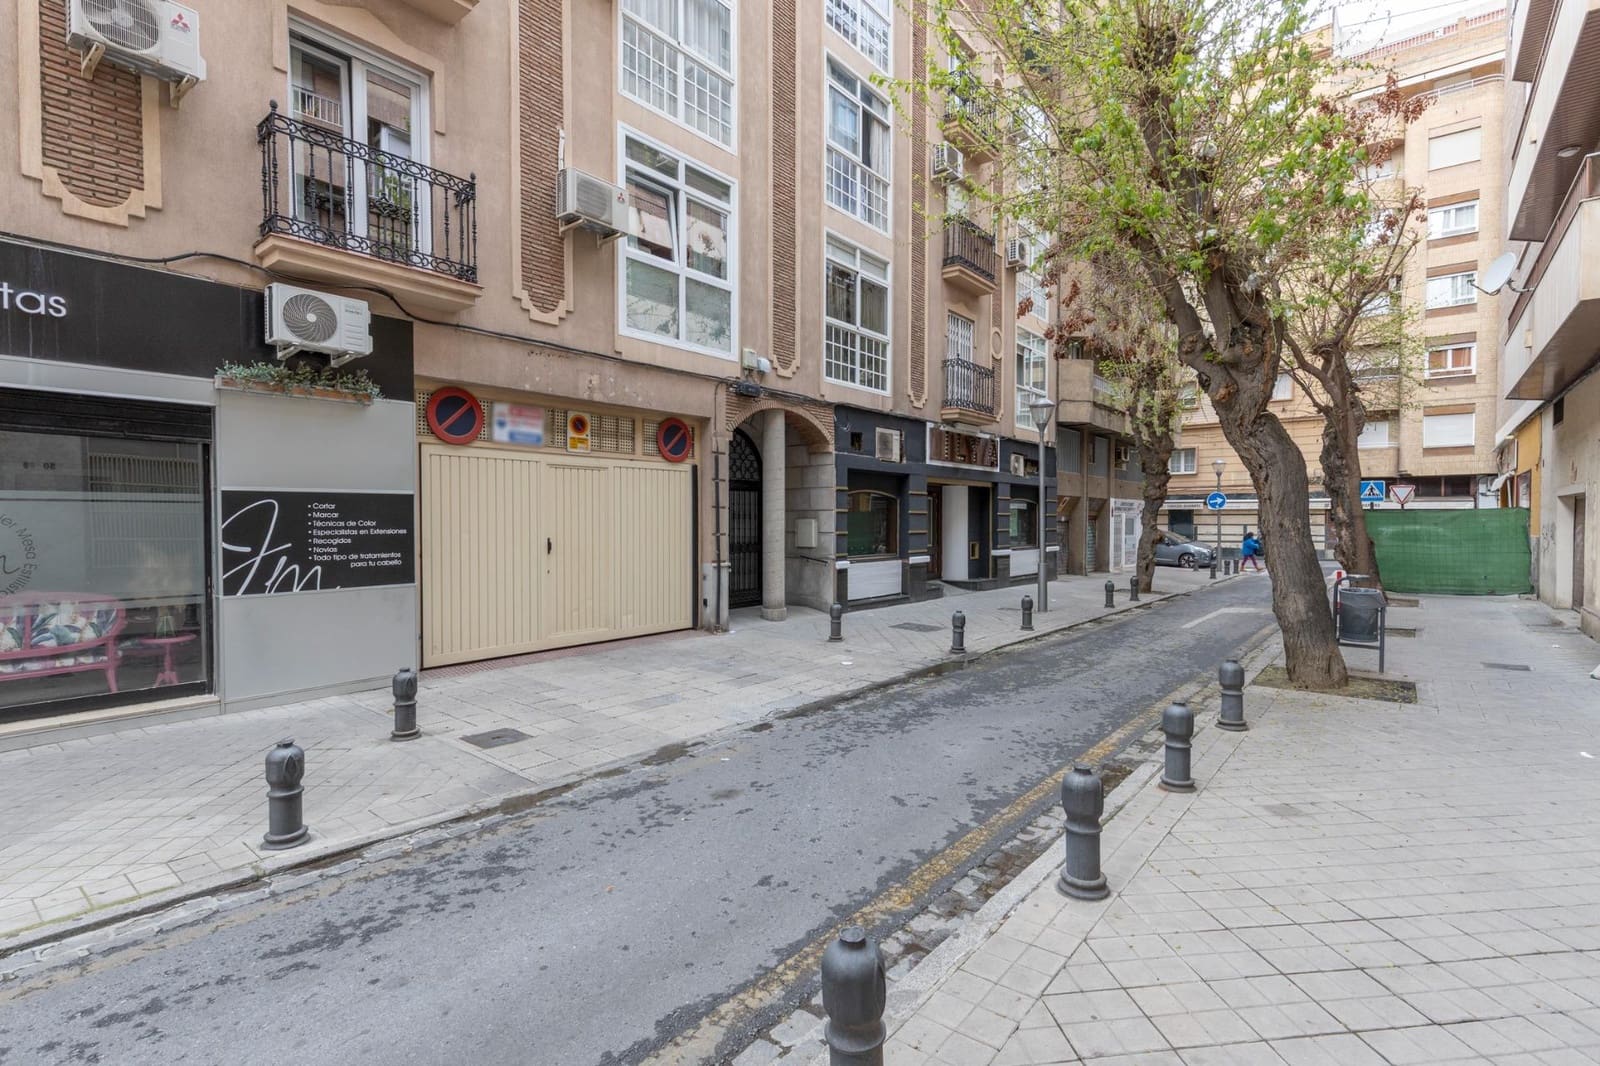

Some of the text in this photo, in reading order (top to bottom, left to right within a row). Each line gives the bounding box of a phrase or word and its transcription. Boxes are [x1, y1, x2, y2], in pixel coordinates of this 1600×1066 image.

[312, 502, 336, 510] Cortar
[313, 528, 358, 536] Especialistas
[16, 527, 37, 560] Mesa
[313, 537, 352, 545] Recogidos
[333, 553, 347, 561] tipo
[360, 551, 401, 559] tratamientos
[376, 558, 402, 566] cabello
